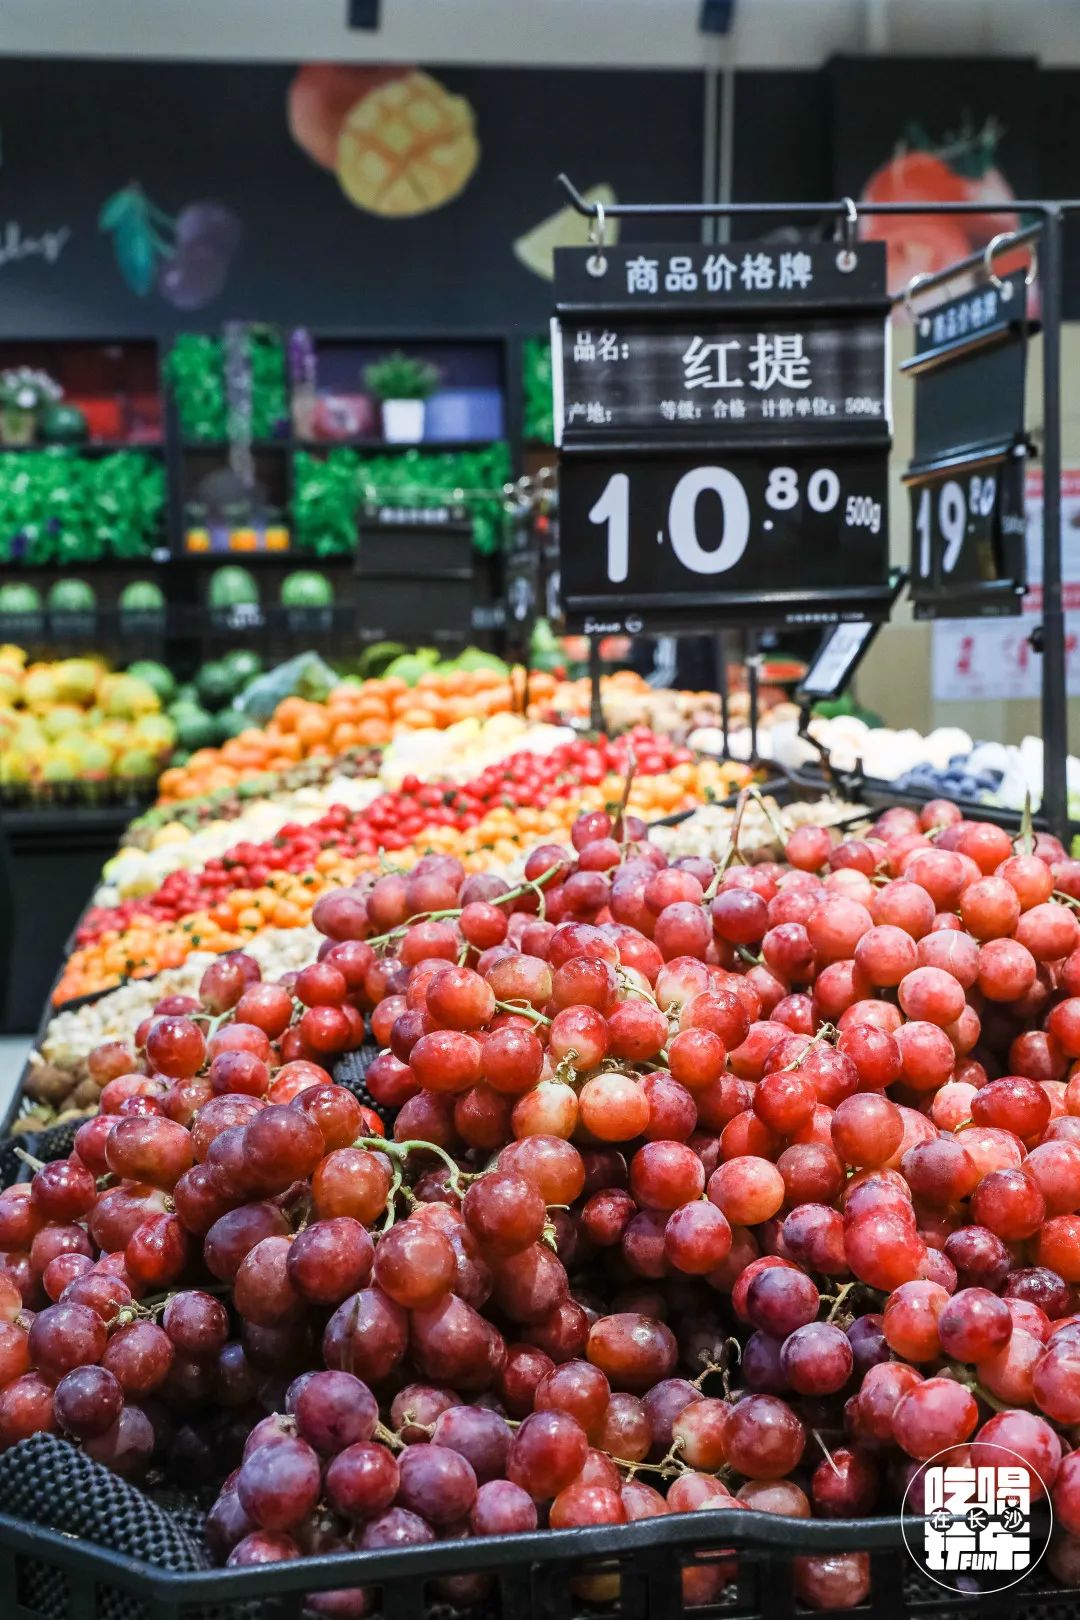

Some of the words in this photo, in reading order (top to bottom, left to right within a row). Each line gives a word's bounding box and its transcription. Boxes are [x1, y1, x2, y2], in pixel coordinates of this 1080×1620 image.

[625, 252, 813, 294] 商品价格牌
[682, 333, 812, 391] 红提
[846, 496, 881, 534] 500g
